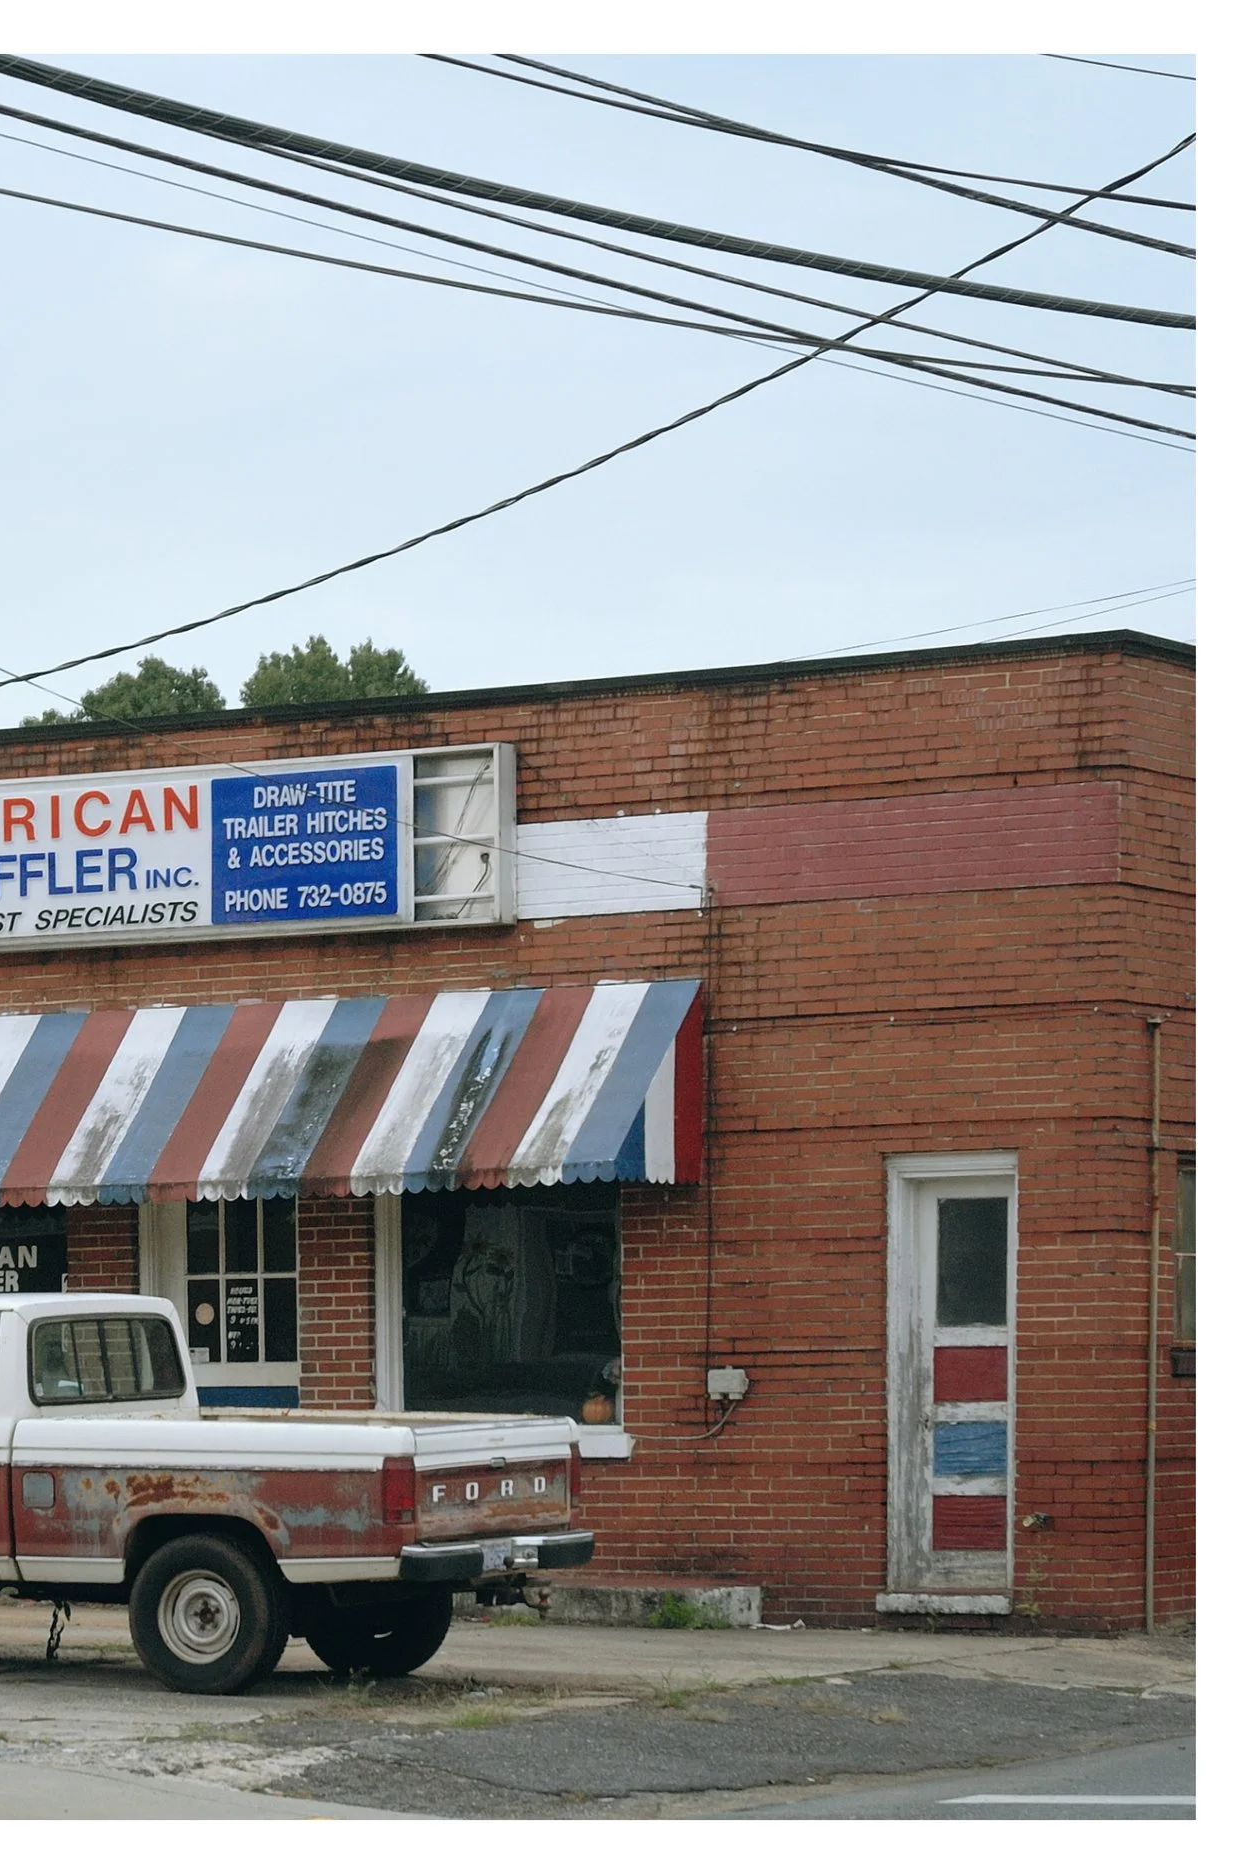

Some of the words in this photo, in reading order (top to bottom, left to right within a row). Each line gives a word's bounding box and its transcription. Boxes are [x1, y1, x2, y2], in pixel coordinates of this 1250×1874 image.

[253, 779, 356, 809] DRAW-TITE
[223, 813, 298, 840] TRAILER
[306, 807, 387, 835] HITCHES
[227, 848, 241, 869] &
[249, 837, 384, 868] ACCESSORIES
[145, 866, 199, 890] INC.
[224, 888, 288, 913] PHONE
[298, 881, 387, 908] 732-0875
[34, 901, 199, 931] SPECIALISTS
[432, 1477, 546, 1502] FORD
